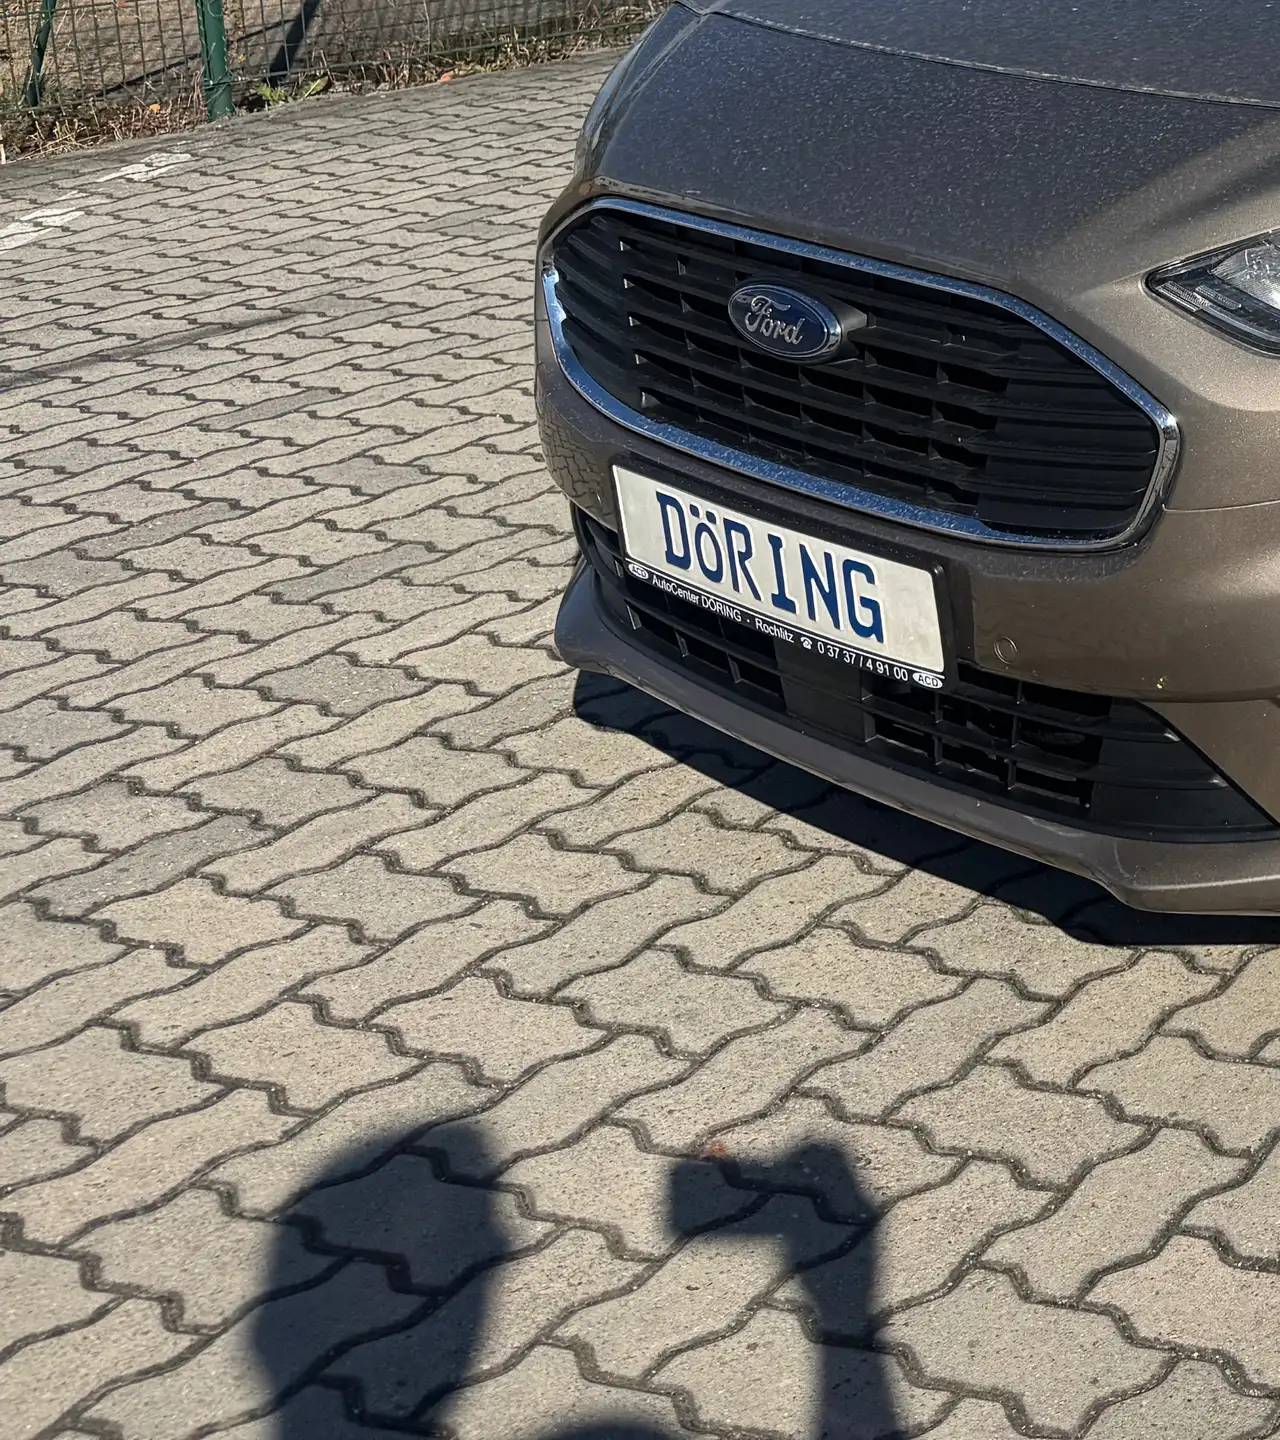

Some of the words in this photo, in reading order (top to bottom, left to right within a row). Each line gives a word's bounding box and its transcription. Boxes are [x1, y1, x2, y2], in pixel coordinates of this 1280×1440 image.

[744, 295, 805, 345] Ford
[656, 491, 883, 642] DÖRING
[652, 575, 700, 604] AutoCenter
[755, 618, 794, 643] Rochlitz
[817, 642, 825, 654] 0
[827, 644, 840, 659] 37
[843, 650, 856, 665] 37
[866, 658, 873, 671] 4
[877, 661, 890, 676] 91
[894, 666, 908, 682] 00
[917, 673, 940, 688] ACD
